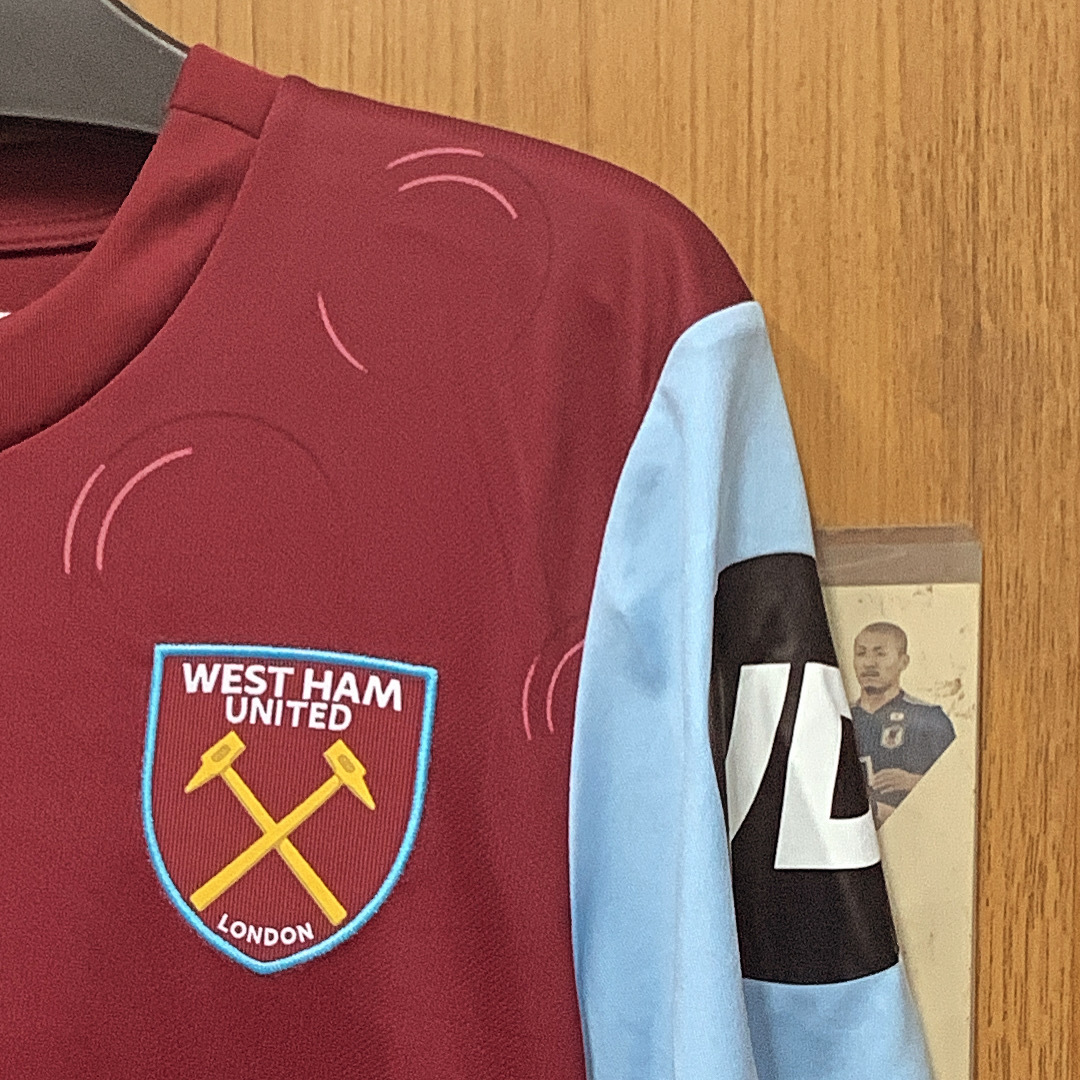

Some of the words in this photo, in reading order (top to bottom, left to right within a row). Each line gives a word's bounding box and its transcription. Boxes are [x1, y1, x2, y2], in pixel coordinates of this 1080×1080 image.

[182, 662, 294, 697] WEST
[301, 668, 403, 712] HAM
[224, 695, 353, 731] UNITED
[216, 913, 315, 946] LONDON
